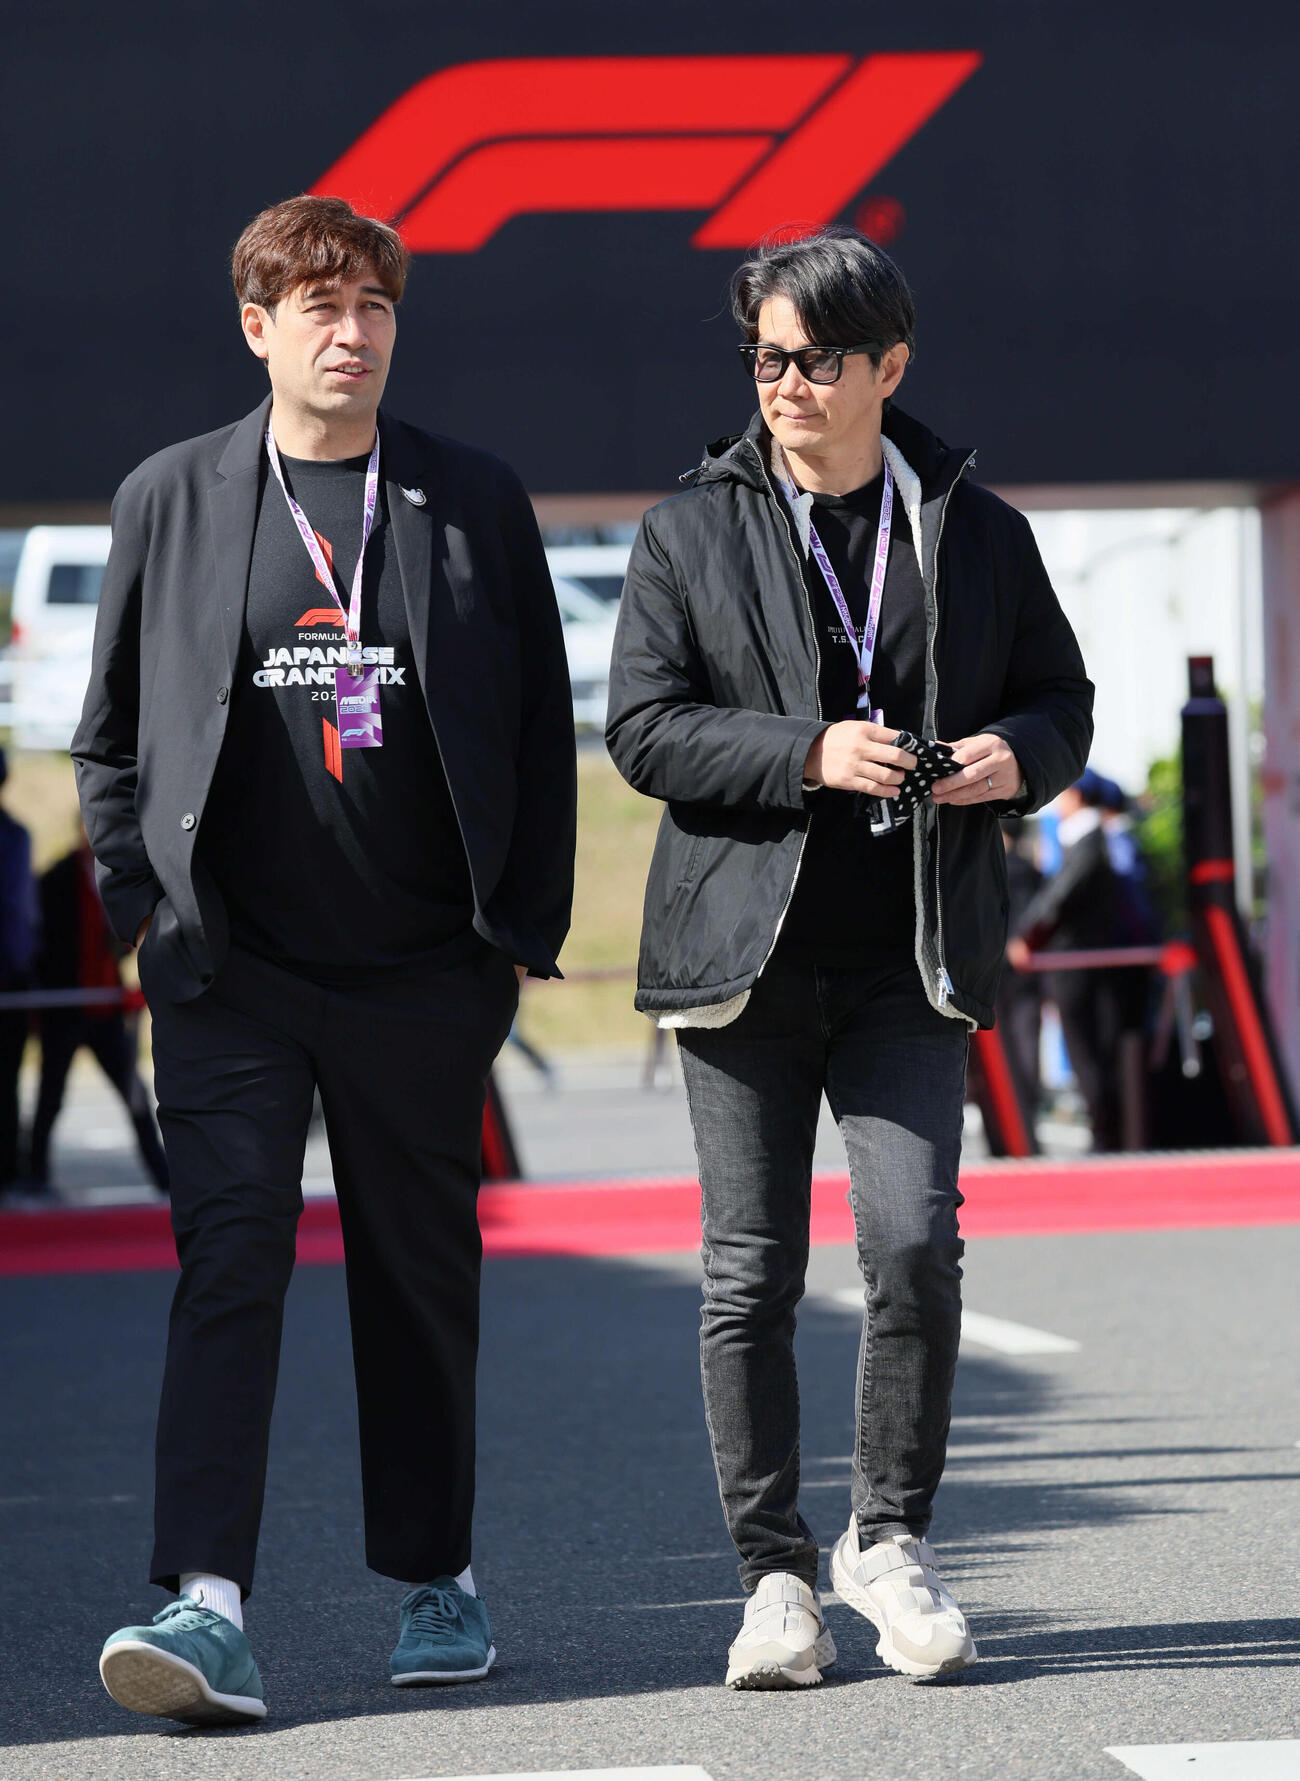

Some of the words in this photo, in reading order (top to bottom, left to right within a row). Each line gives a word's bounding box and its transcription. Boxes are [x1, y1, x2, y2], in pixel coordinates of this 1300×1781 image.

[307, 51, 982, 252] F1
[367, 480, 376, 511] MEDIA
[878, 527, 889, 559] MEDIA
[817, 553, 833, 574] F1
[298, 632, 348, 641] FORMULA
[262, 646, 395, 667] JAPANSE
[311, 691, 338, 701] 202
[339, 695, 378, 705] MEDIA
[341, 728, 366, 737] F1
